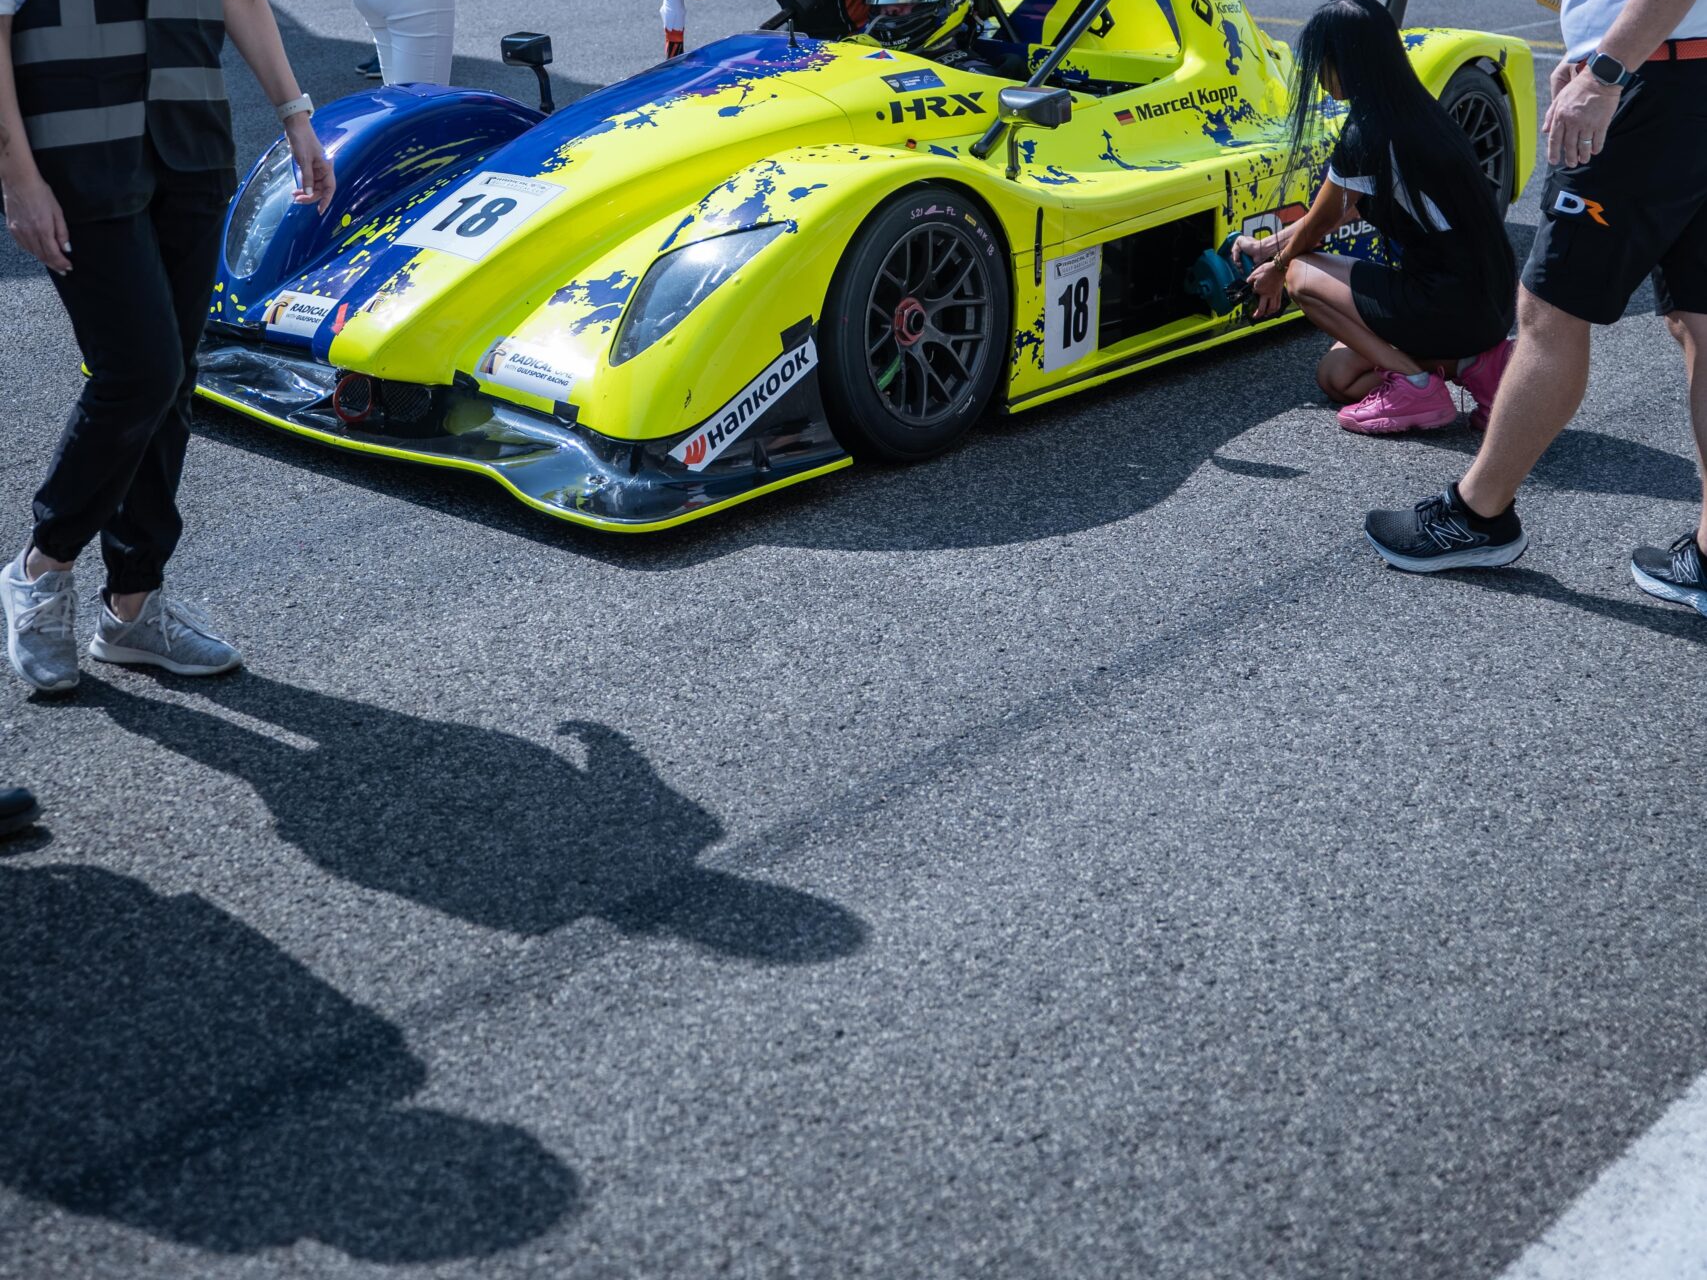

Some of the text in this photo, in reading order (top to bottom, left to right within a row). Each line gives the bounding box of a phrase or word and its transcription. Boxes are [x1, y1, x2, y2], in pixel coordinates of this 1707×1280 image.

[889, 91, 987, 124] HRX
[1135, 85, 1238, 121] Marcel Kopp
[432, 194, 518, 237] 18
[1554, 191, 1609, 226] DR
[1338, 220, 1376, 240] DUB
[290, 303, 329, 317] RADICAL
[1058, 276, 1089, 350] 18
[509, 353, 553, 373] RADICAL
[516, 366, 548, 380] GULFSPORT
[547, 375, 570, 386] RACING
